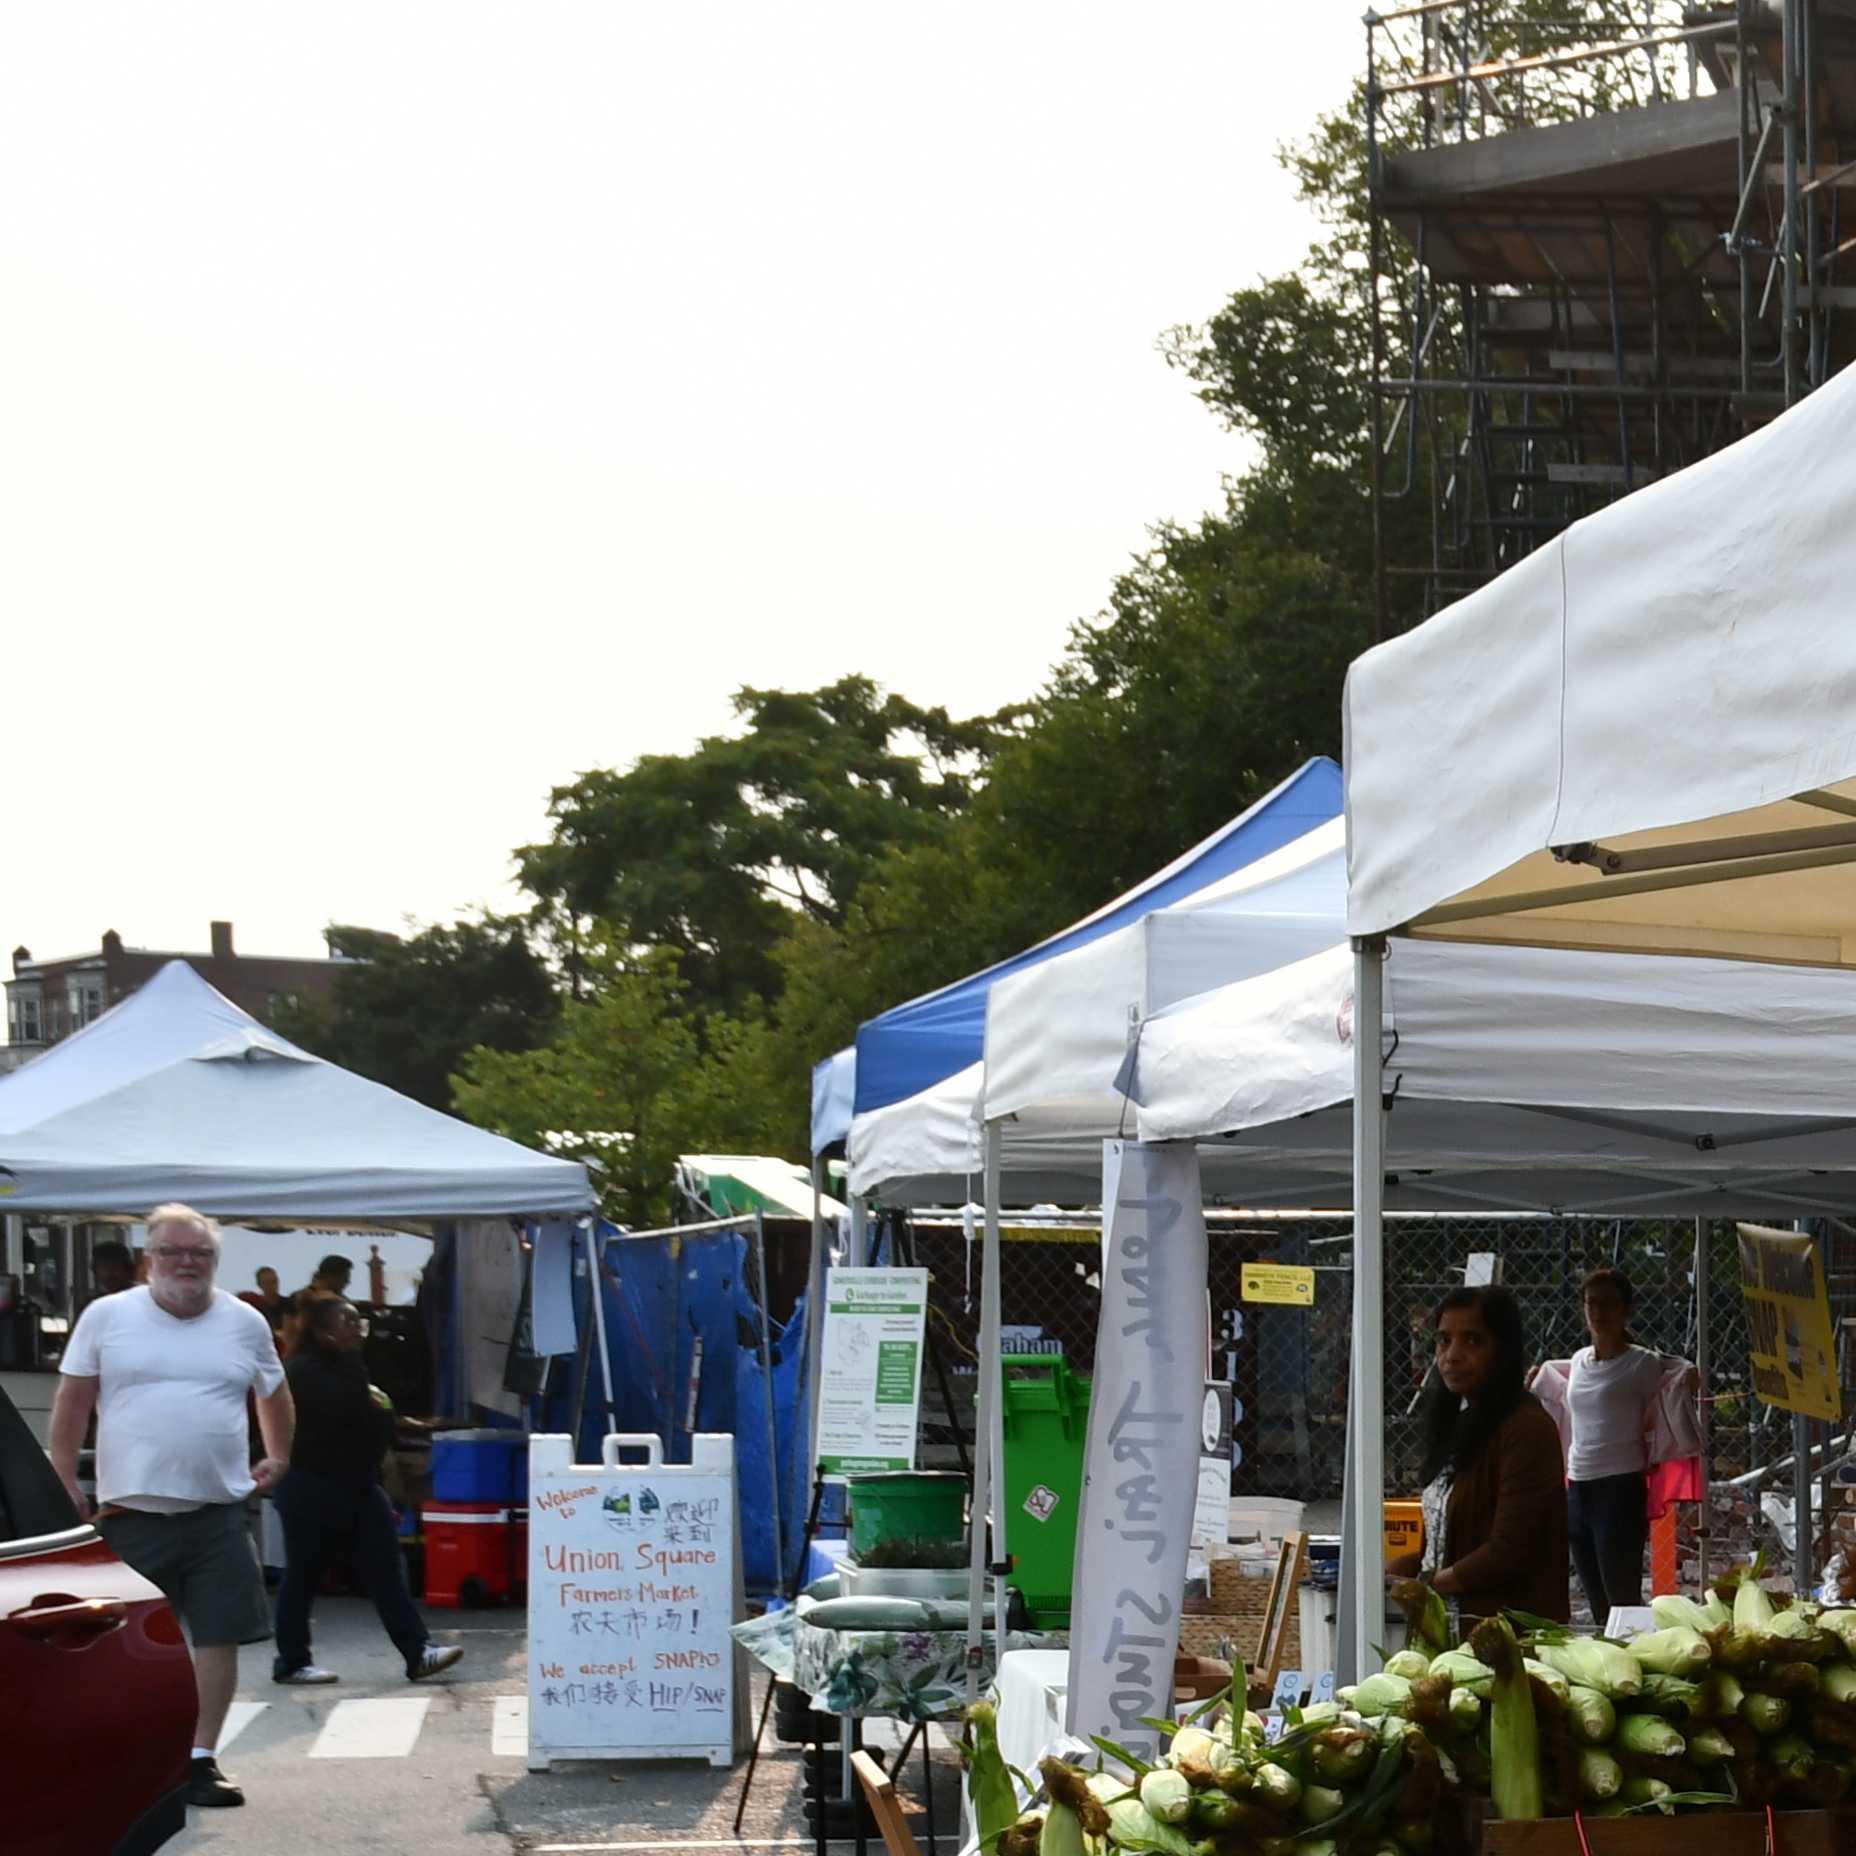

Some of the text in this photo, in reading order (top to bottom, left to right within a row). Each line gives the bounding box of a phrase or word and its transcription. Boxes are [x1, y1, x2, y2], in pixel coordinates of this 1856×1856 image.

[544, 1543, 717, 1577] Union Square
[639, 1582, 699, 1603] Market
[540, 1661, 566, 1679] We
[578, 1655, 638, 1680] accept
